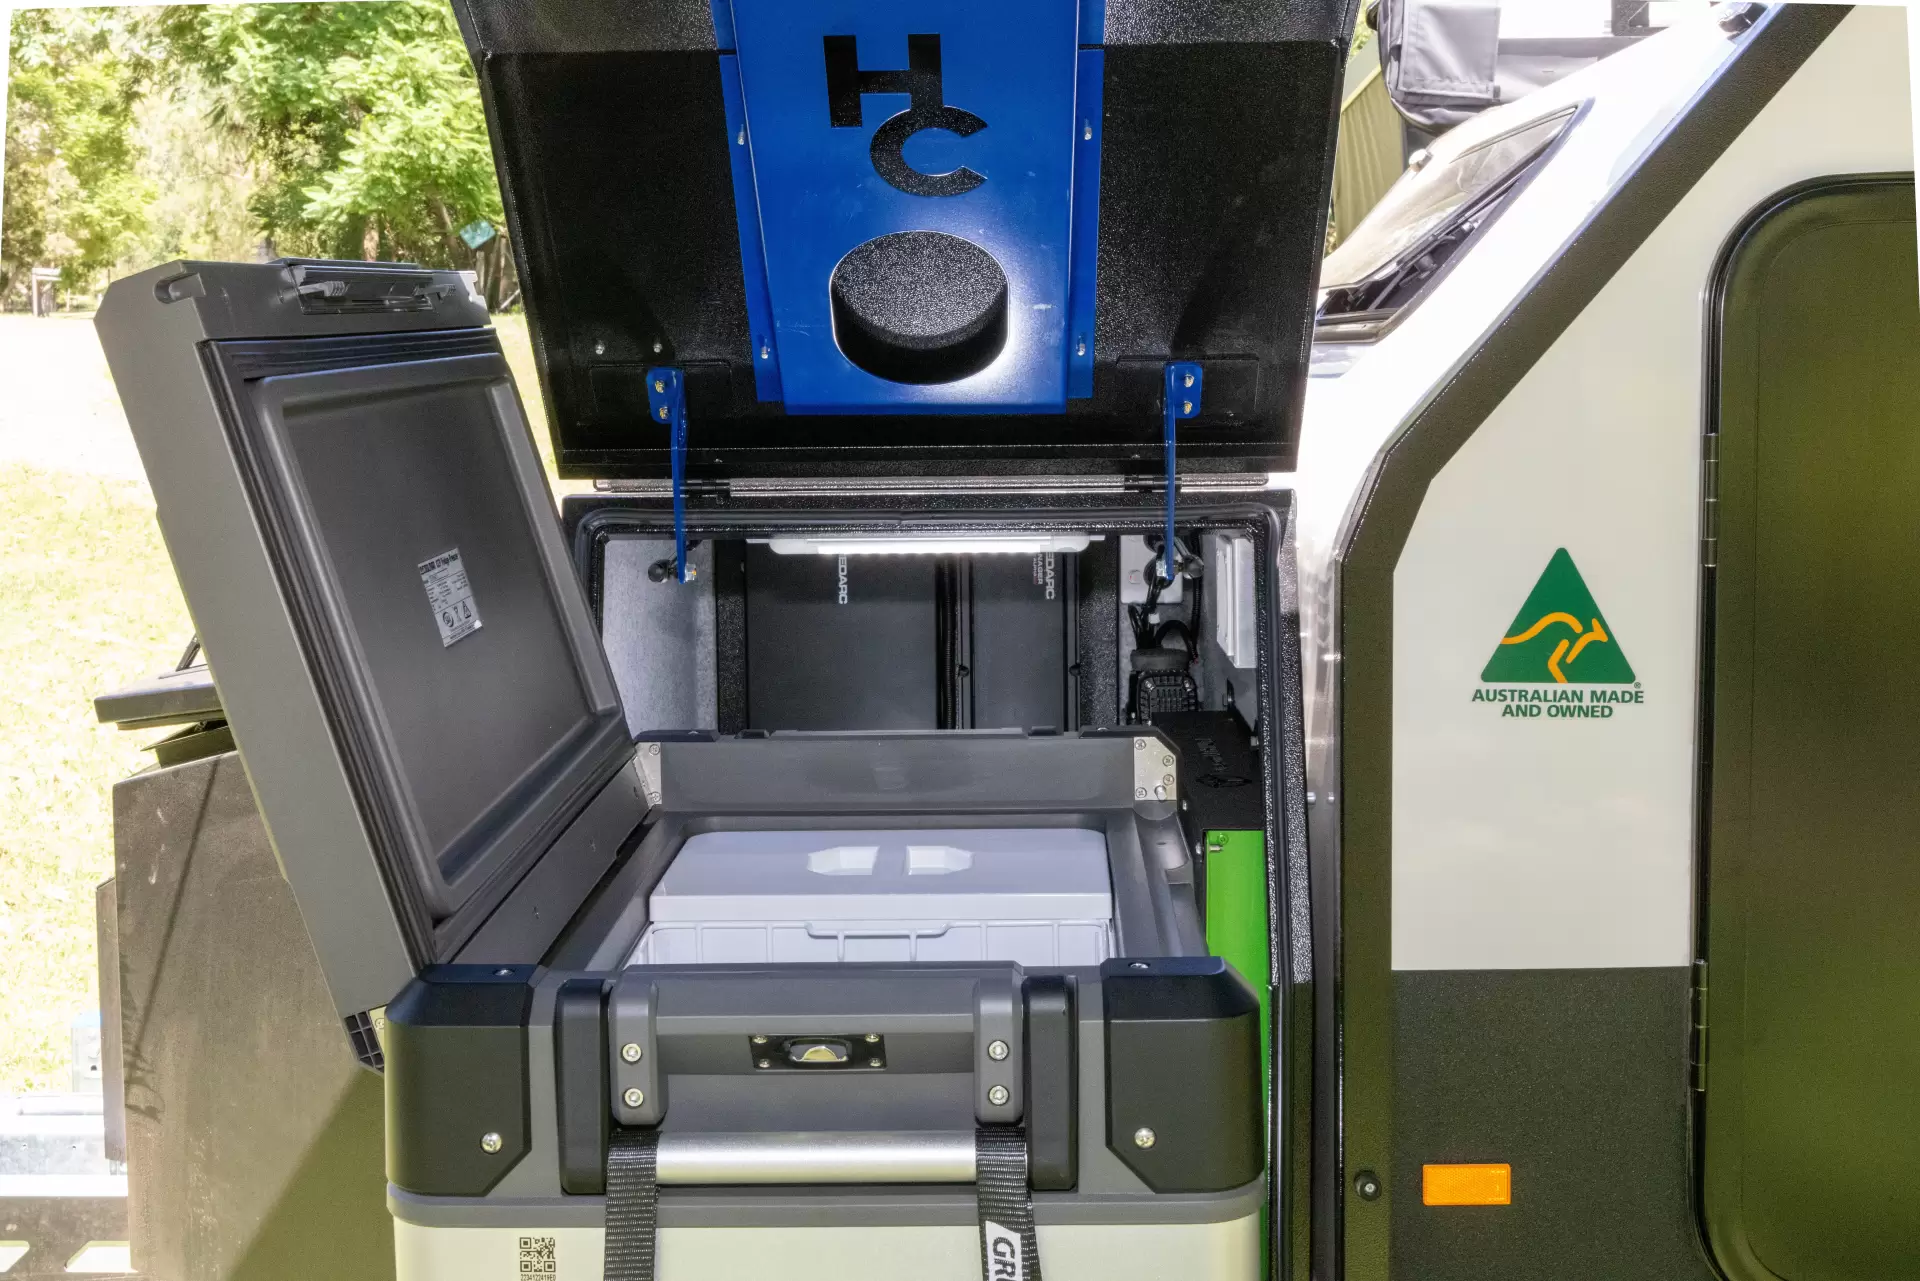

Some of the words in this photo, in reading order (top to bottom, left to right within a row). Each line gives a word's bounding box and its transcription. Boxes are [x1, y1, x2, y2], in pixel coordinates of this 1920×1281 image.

[838, 554, 848, 604] EDARC
[1045, 552, 1055, 600] EDARC
[1471, 688, 1584, 704] AUSTRALIAN
[1590, 690, 1645, 704] MADE
[1501, 704, 1542, 718] AND
[1546, 704, 1614, 719] OWNED
[992, 1236, 1017, 1281] GR
